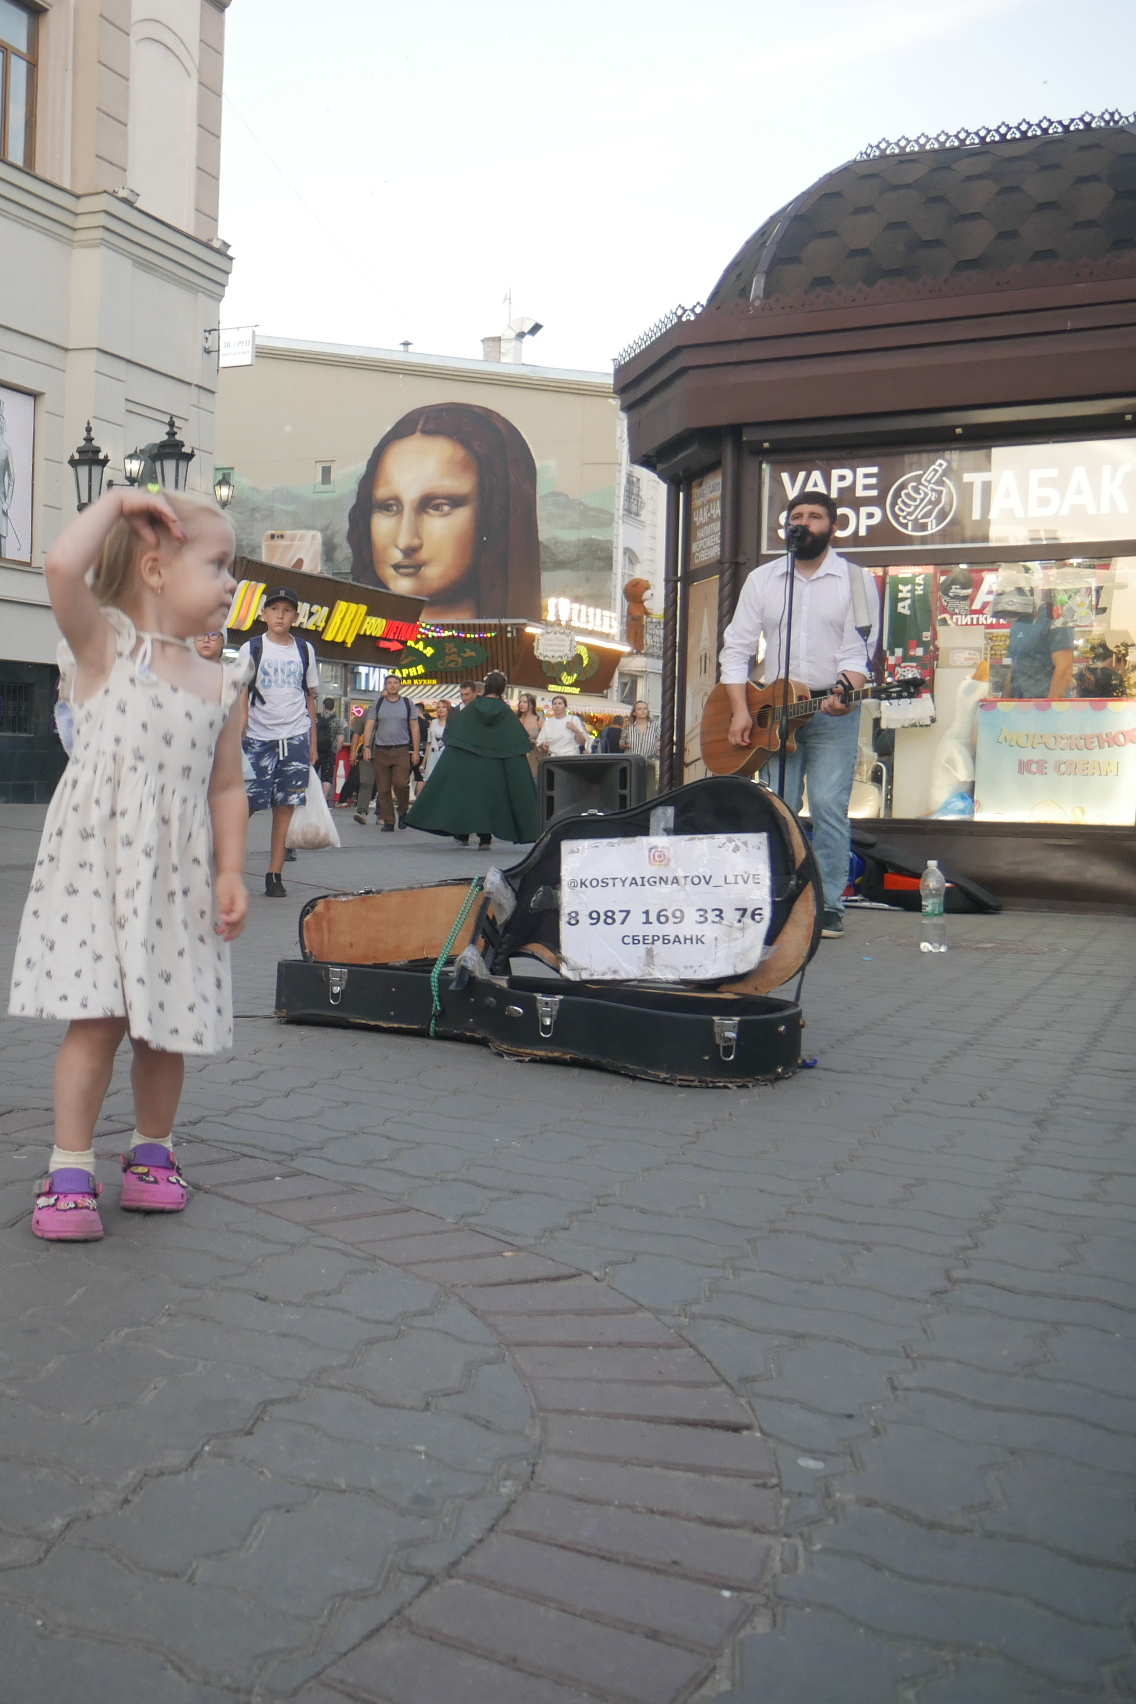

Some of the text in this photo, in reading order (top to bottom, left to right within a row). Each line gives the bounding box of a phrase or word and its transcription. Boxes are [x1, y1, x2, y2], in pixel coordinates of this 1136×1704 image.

[780, 466, 879, 501] VAPE
[962, 463, 1132, 520] ТАБАК
[693, 500, 722, 526] ЧАК-ЧА
[777, 506, 883, 540] OP
[692, 532, 721, 553] МОРОЖЕНО
[321, 600, 368, 647] BBQ
[360, 615, 387, 637] FOOD
[952, 614, 999, 626] ПИТКИ
[260, 660, 304, 690] SUR
[1017, 758, 1119, 777] ICE CREAM
[567, 873, 761, 890] @KOSTYAIGNATOV_LIVE
[566, 907, 764, 926] 8 987 169 33 76
[621, 933, 706, 945] СБЕРБАНК
